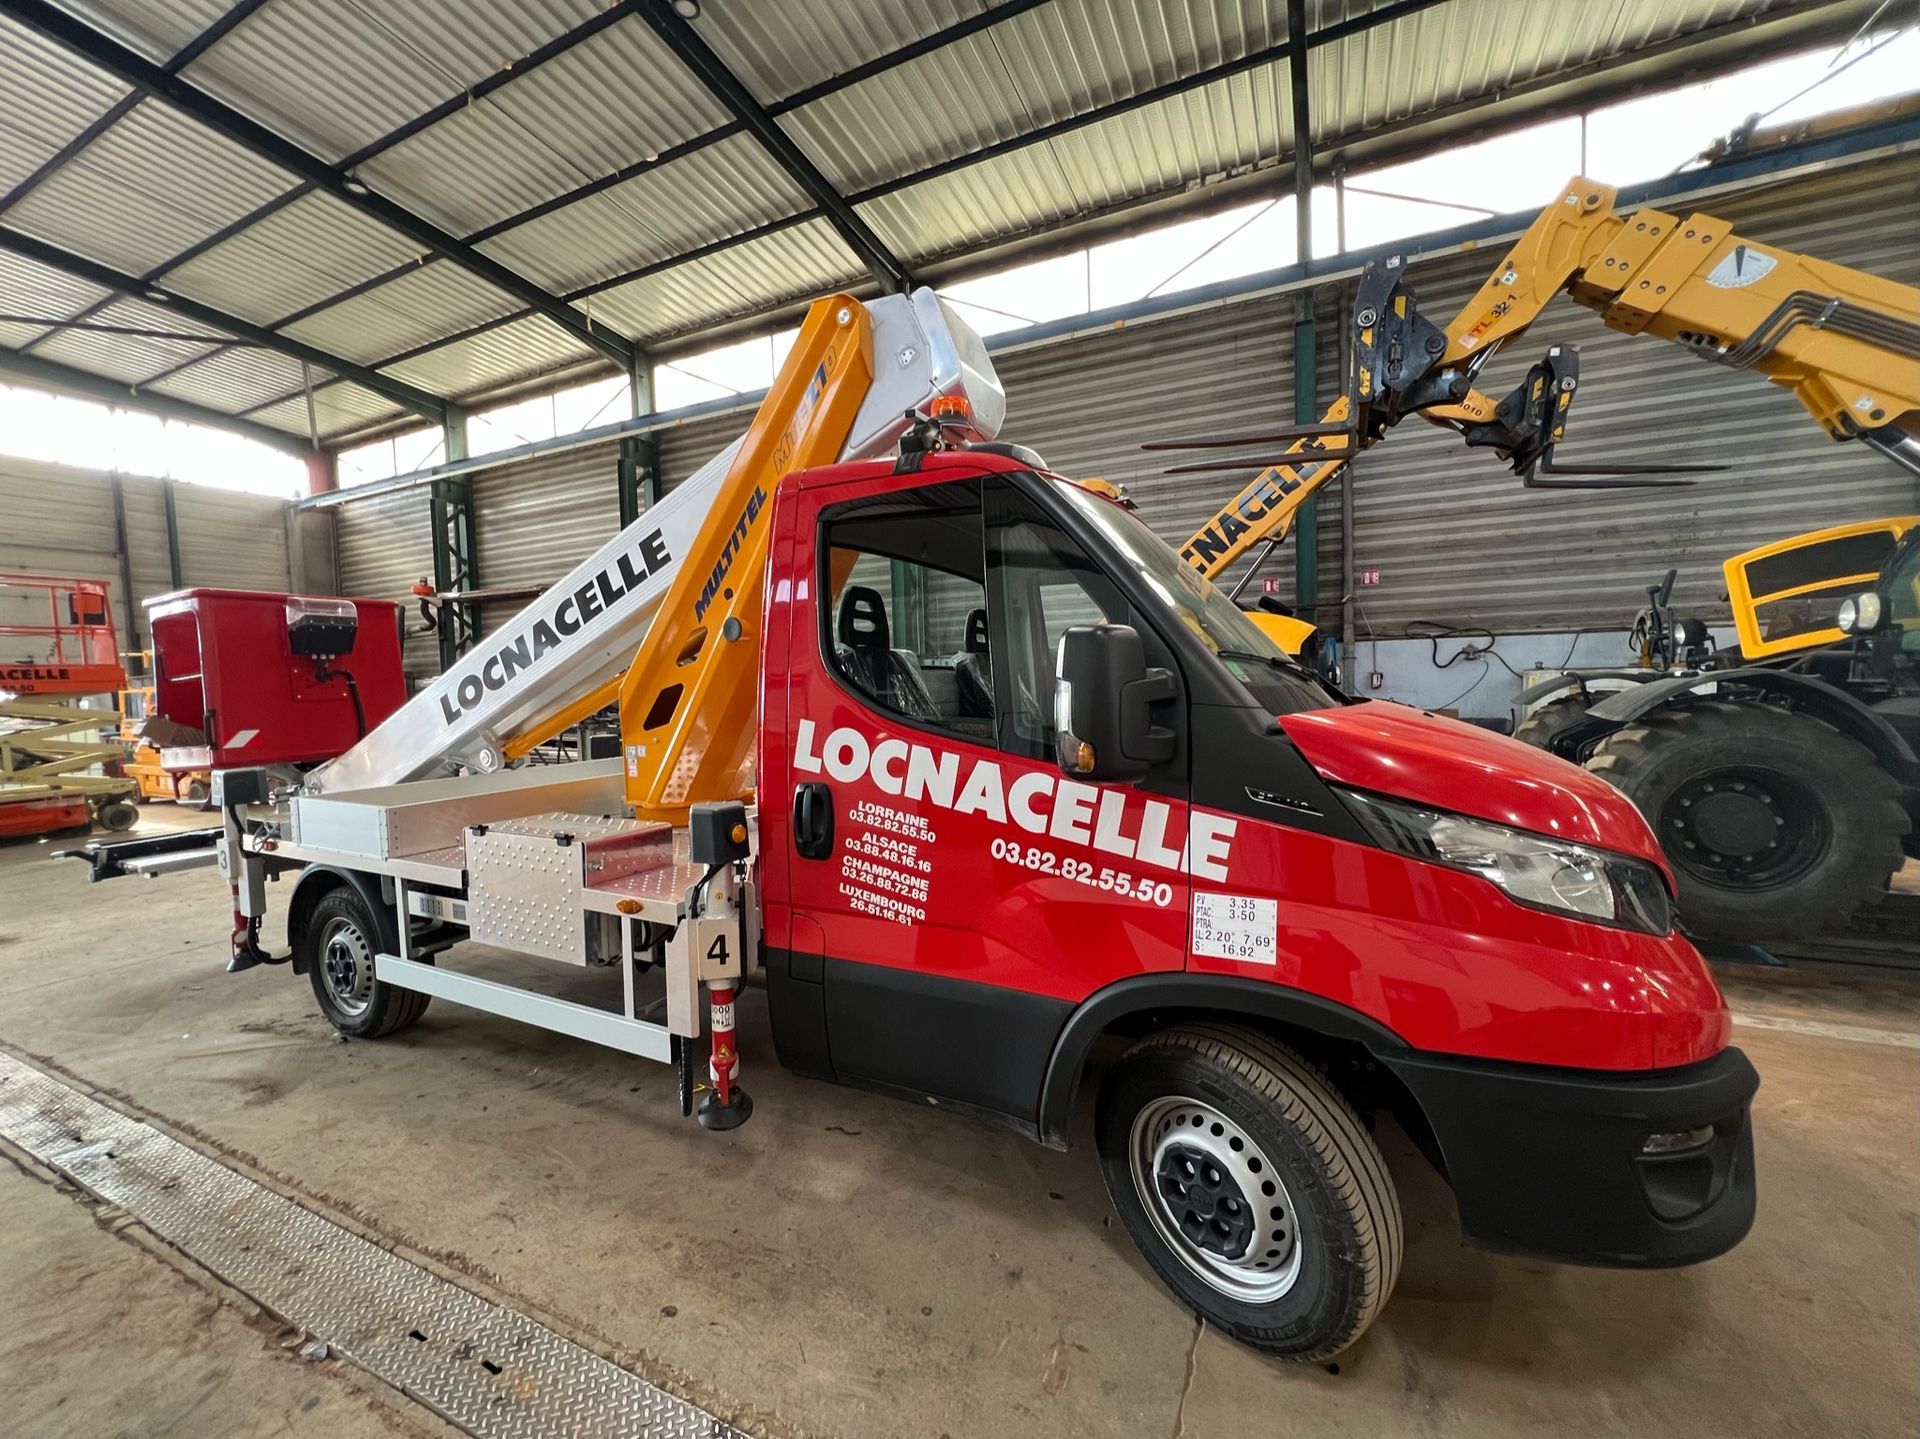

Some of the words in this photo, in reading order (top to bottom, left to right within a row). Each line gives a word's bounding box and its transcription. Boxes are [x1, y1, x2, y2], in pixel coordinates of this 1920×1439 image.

[694, 485, 768, 624] MULTITEL
[439, 527, 673, 726] LOCNACELLE
[793, 719, 1238, 883] LOCNACELLE
[858, 800, 929, 829] LORRAINE
[849, 809, 936, 843] 03.82.82.55.50
[220, 850, 228, 870] 3
[845, 838, 931, 873] 03.88.48.16.16
[862, 832, 917, 857] ALSACE
[842, 866, 928, 902] 03.26.88.72.86
[843, 855, 929, 891] CHAMPAGNE
[991, 838, 1173, 907] 03.82.82.55.50
[839, 882, 925, 921] LUXEMBOURG
[850, 898, 912, 927] 26.51.16.61
[1229, 897, 1255, 910] 3.35
[1229, 909, 1255, 921] 3.50
[706, 934, 730, 965] 4
[1222, 944, 1254, 958] 16.92
